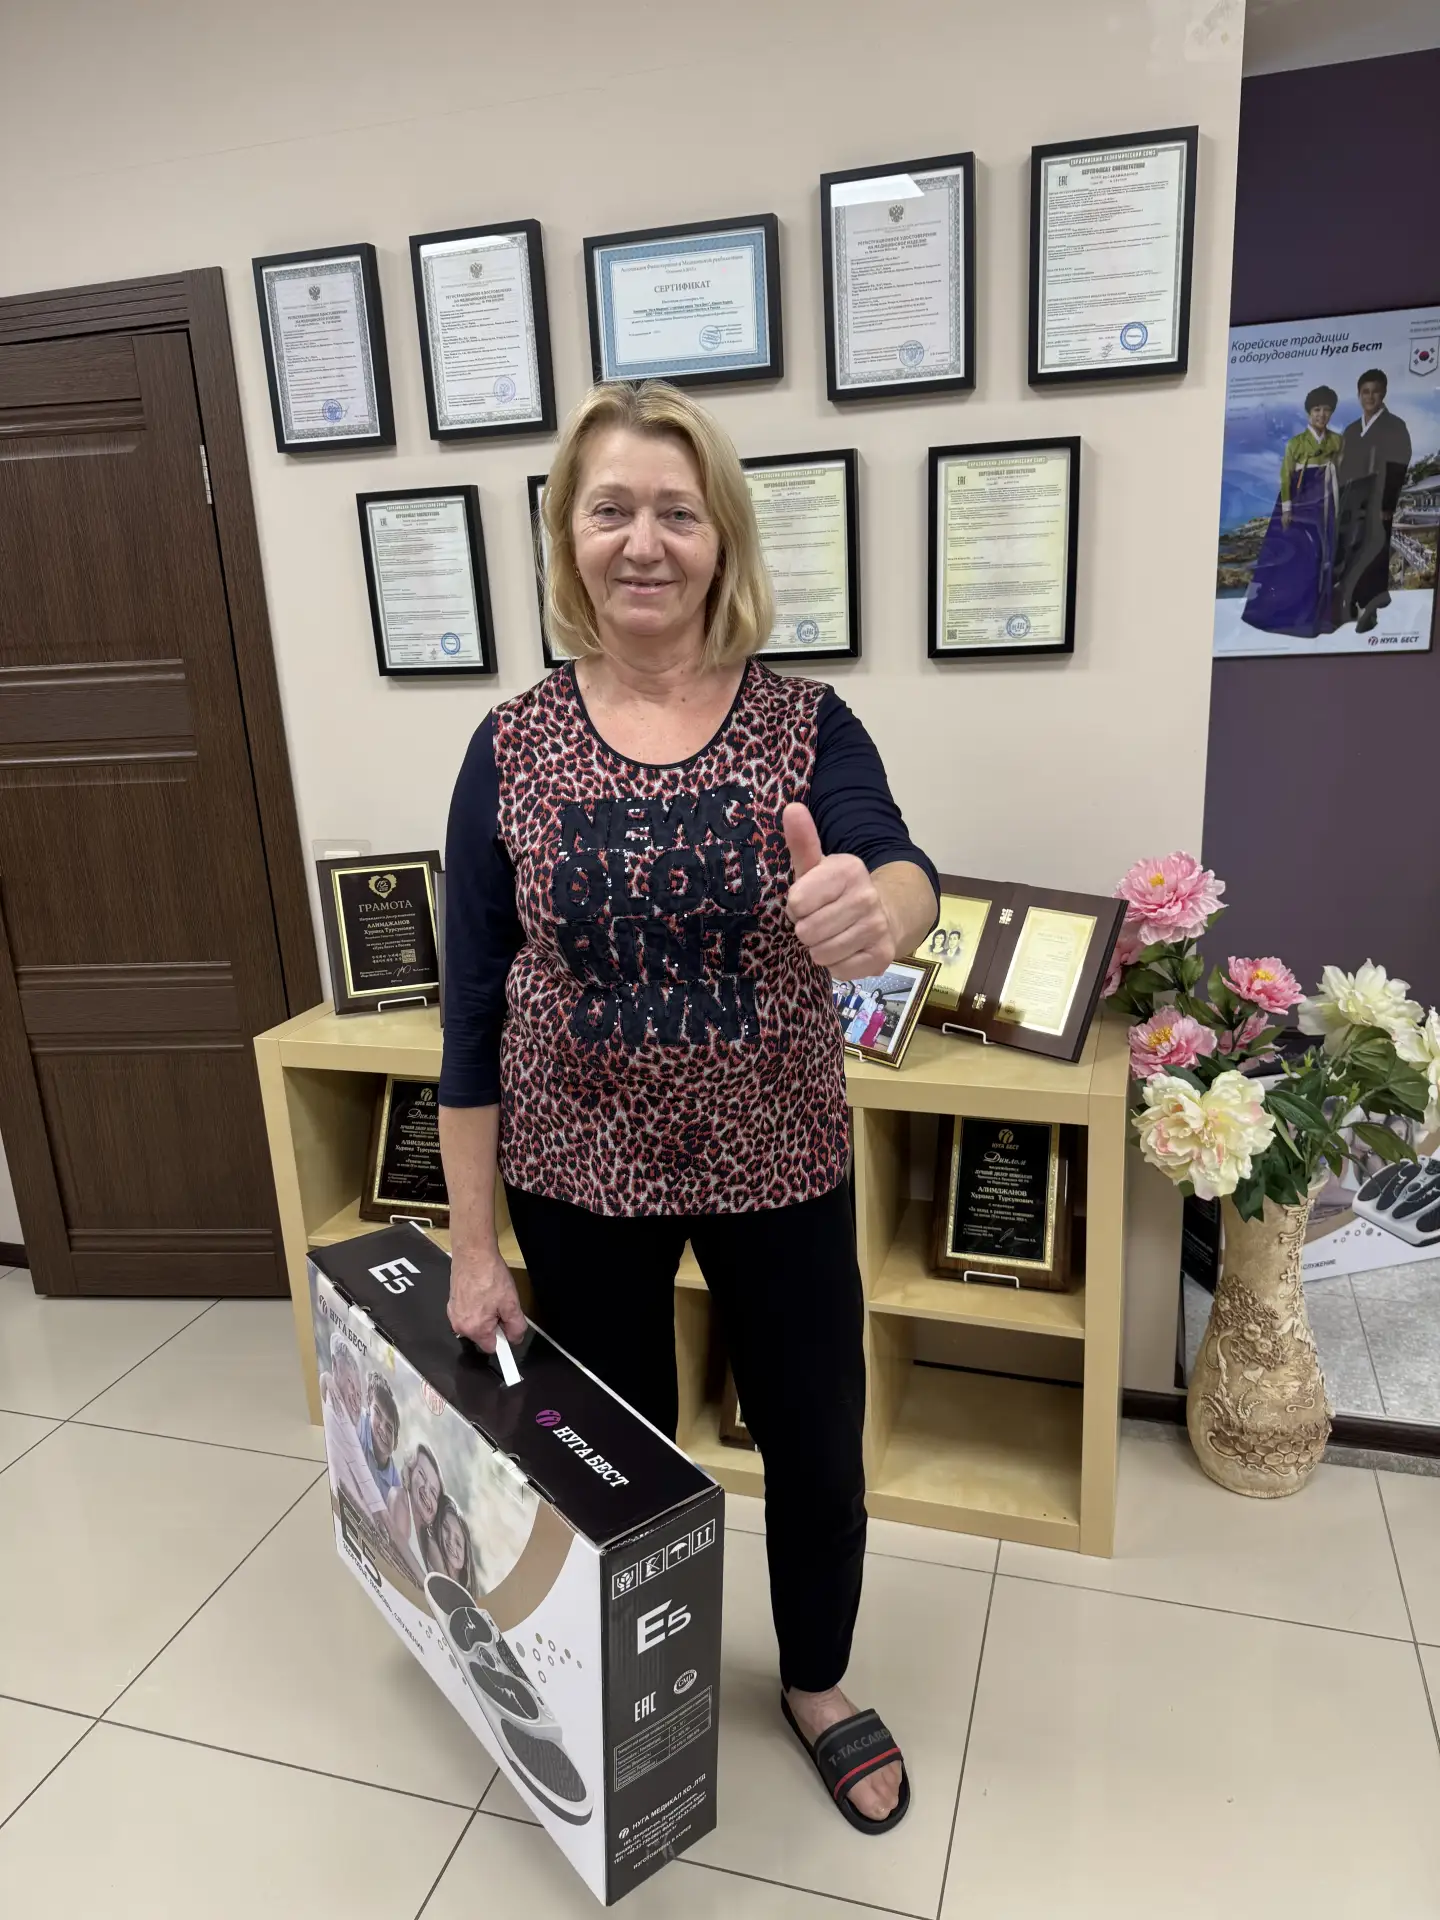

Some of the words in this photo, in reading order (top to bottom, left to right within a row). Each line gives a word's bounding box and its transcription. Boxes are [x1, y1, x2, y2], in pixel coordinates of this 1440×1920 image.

[654, 280, 712, 293] СЕРТИФИКАТ
[1230, 356, 1237, 364] в
[1239, 347, 1319, 364] оборудовании
[1320, 344, 1349, 357] Нуга
[1351, 341, 1383, 352] Бест
[1231, 338, 1289, 352] Корейские
[1290, 332, 1350, 347] традиции
[1380, 636, 1398, 644] НУГА
[1400, 635, 1419, 643] БЕСТ
[358, 900, 413, 913] ГРАМОТА
[407, 1108, 439, 1120] Дипло
[983, 1150, 1027, 1166] Диплом
[368, 1257, 421, 1294] E5
[329, 1307, 348, 1337] НУГА
[347, 1327, 368, 1357] БЕСТ
[552, 1425, 594, 1459] НУГА
[584, 1454, 630, 1488] БЕСТ
[637, 1599, 692, 1655] E5
[634, 1691, 657, 1723] EAC
[632, 1814, 650, 1830] НУГА
[650, 1791, 682, 1818] МЕДИКАЛ
[633, 1841, 671, 1870] ИЗГОТОВЛЕНО
